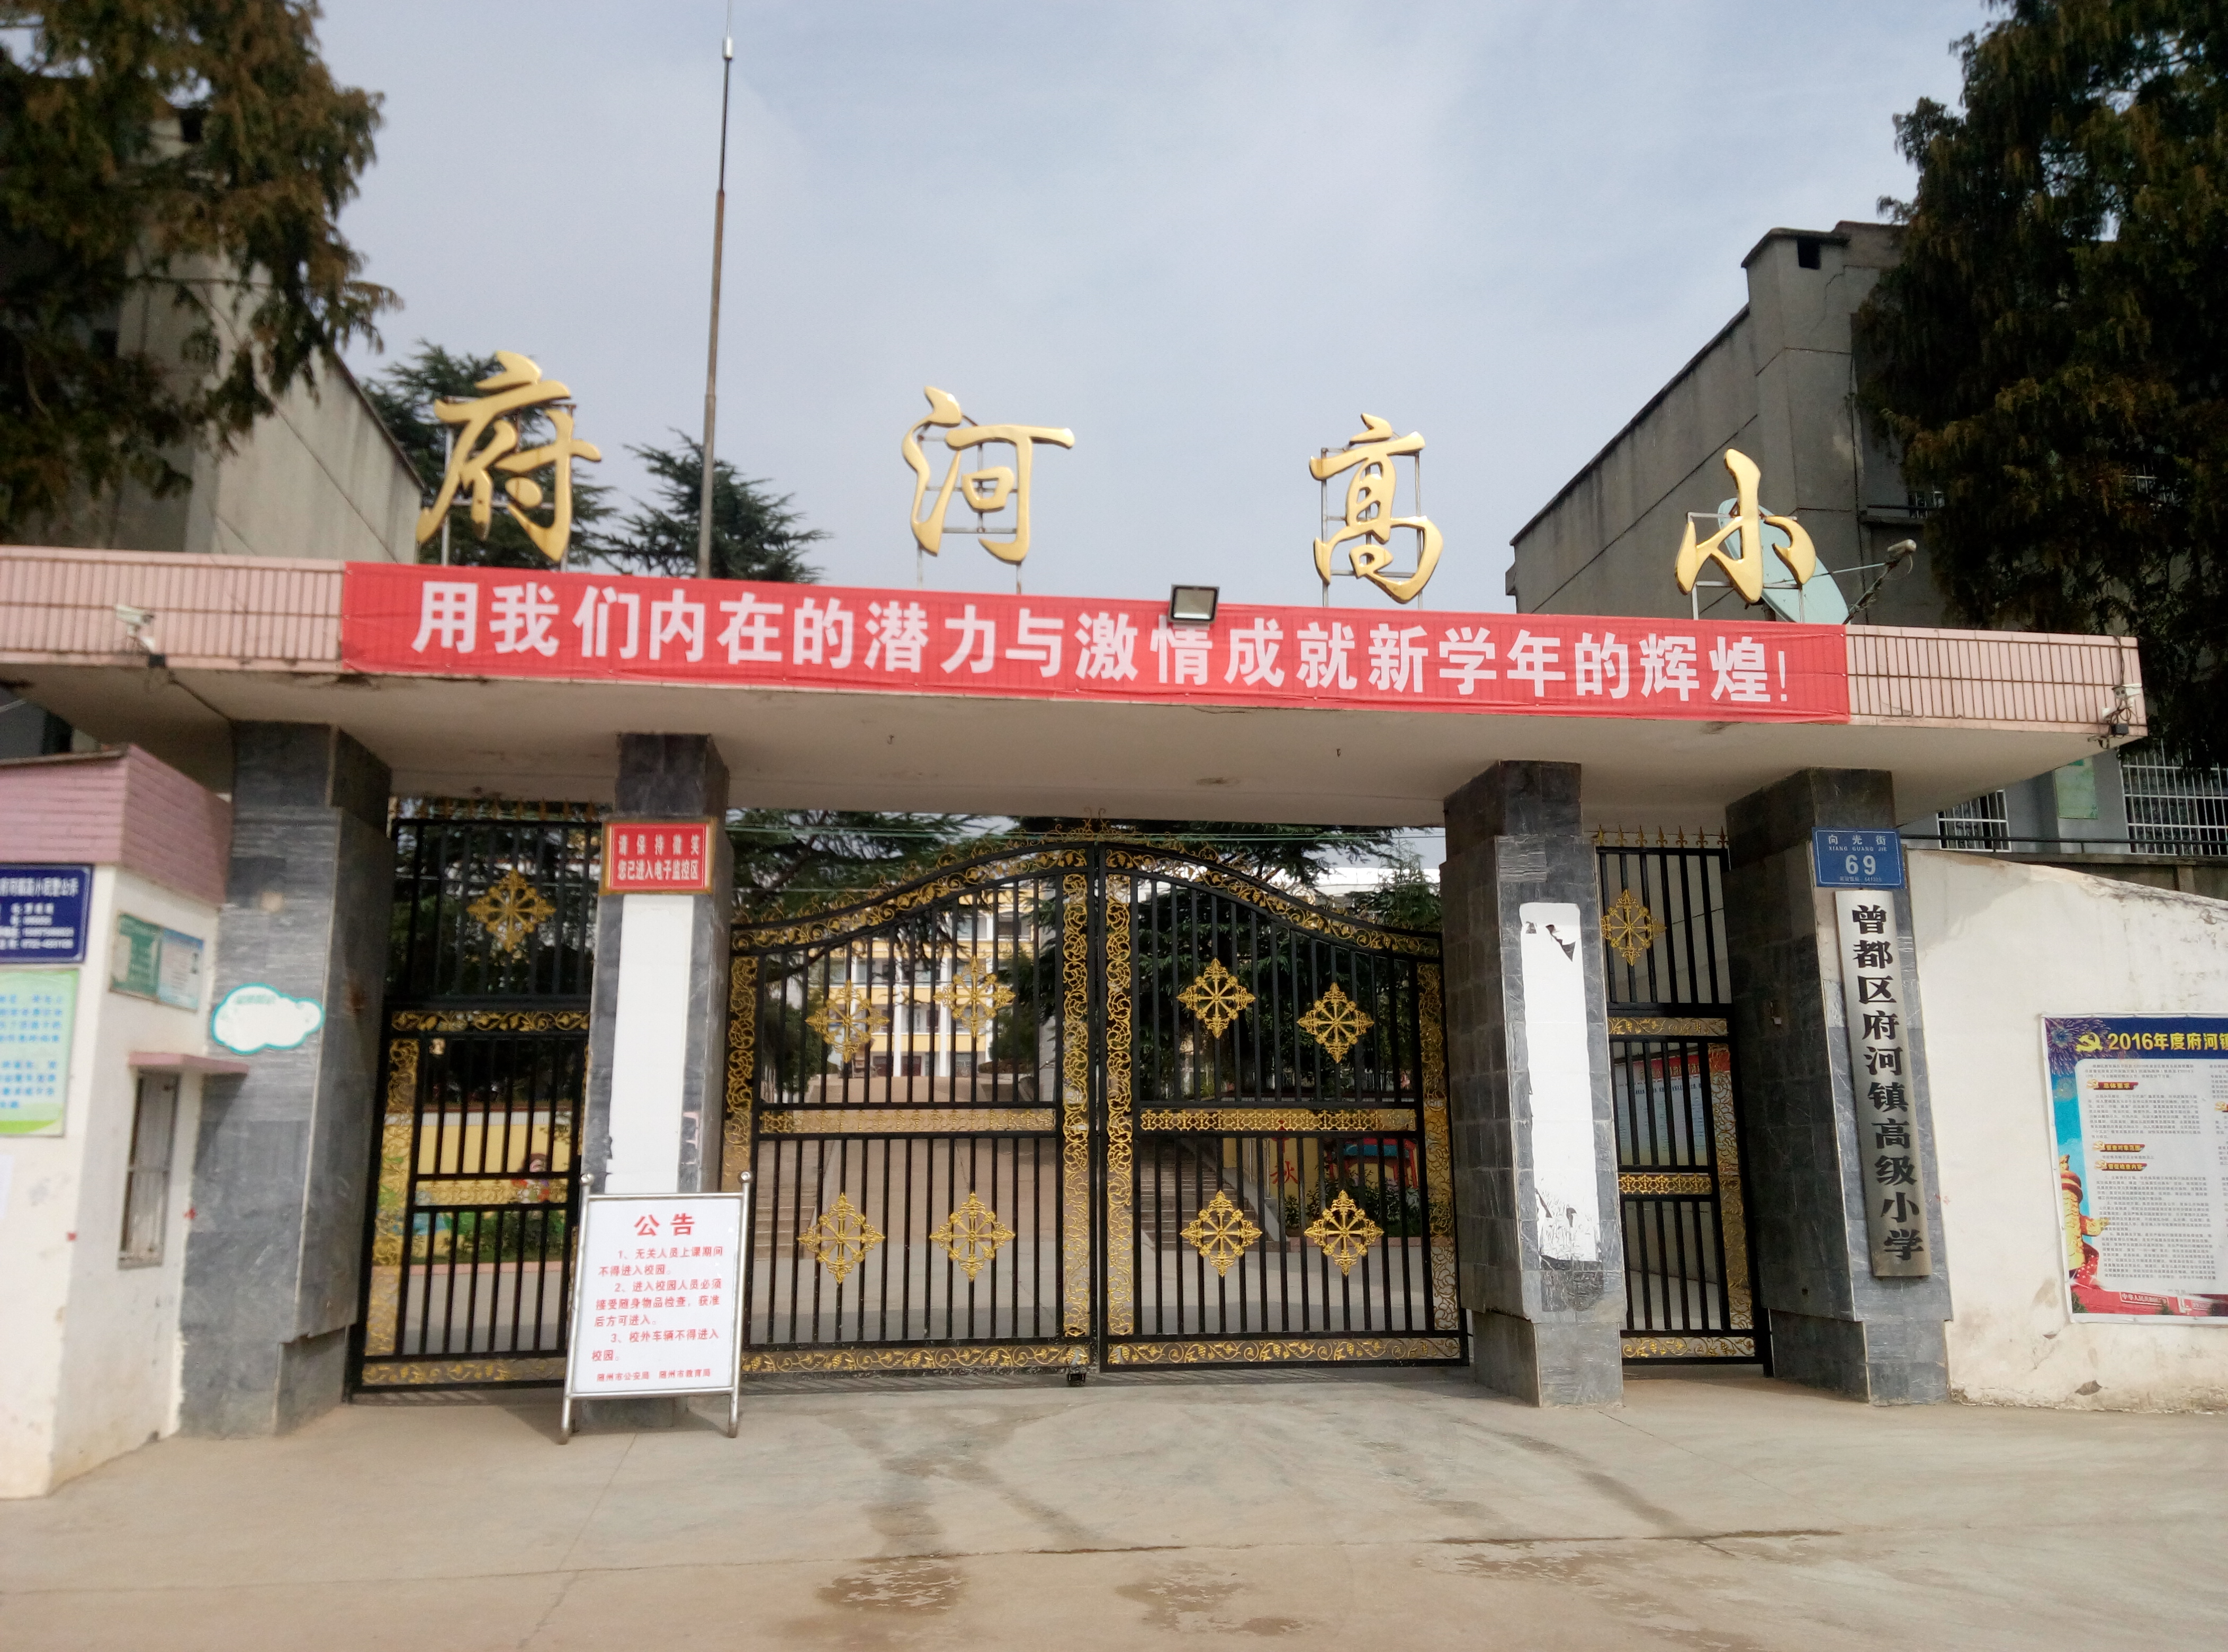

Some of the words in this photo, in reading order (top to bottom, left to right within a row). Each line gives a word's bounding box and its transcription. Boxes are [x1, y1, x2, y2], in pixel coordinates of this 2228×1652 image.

[618, 834, 700, 856] 请保持微笑
[1828, 834, 1886, 846] 向光街
[617, 859, 699, 881] 您已进入电子监控区
[1845, 854, 1876, 876] 69
[1852, 904, 1925, 1261] 曾都区府河镇高级小学
[633, 1213, 695, 1236] 公告
[618, 1246, 723, 1260] 1、无关人员上课期间
[598, 1264, 672, 1277] 不得进入校园。
[614, 1278, 722, 1292] 2、进入校园人员必须
[594, 1314, 657, 1327] 后方可进入。
[591, 1350, 621, 1362] 校园。
